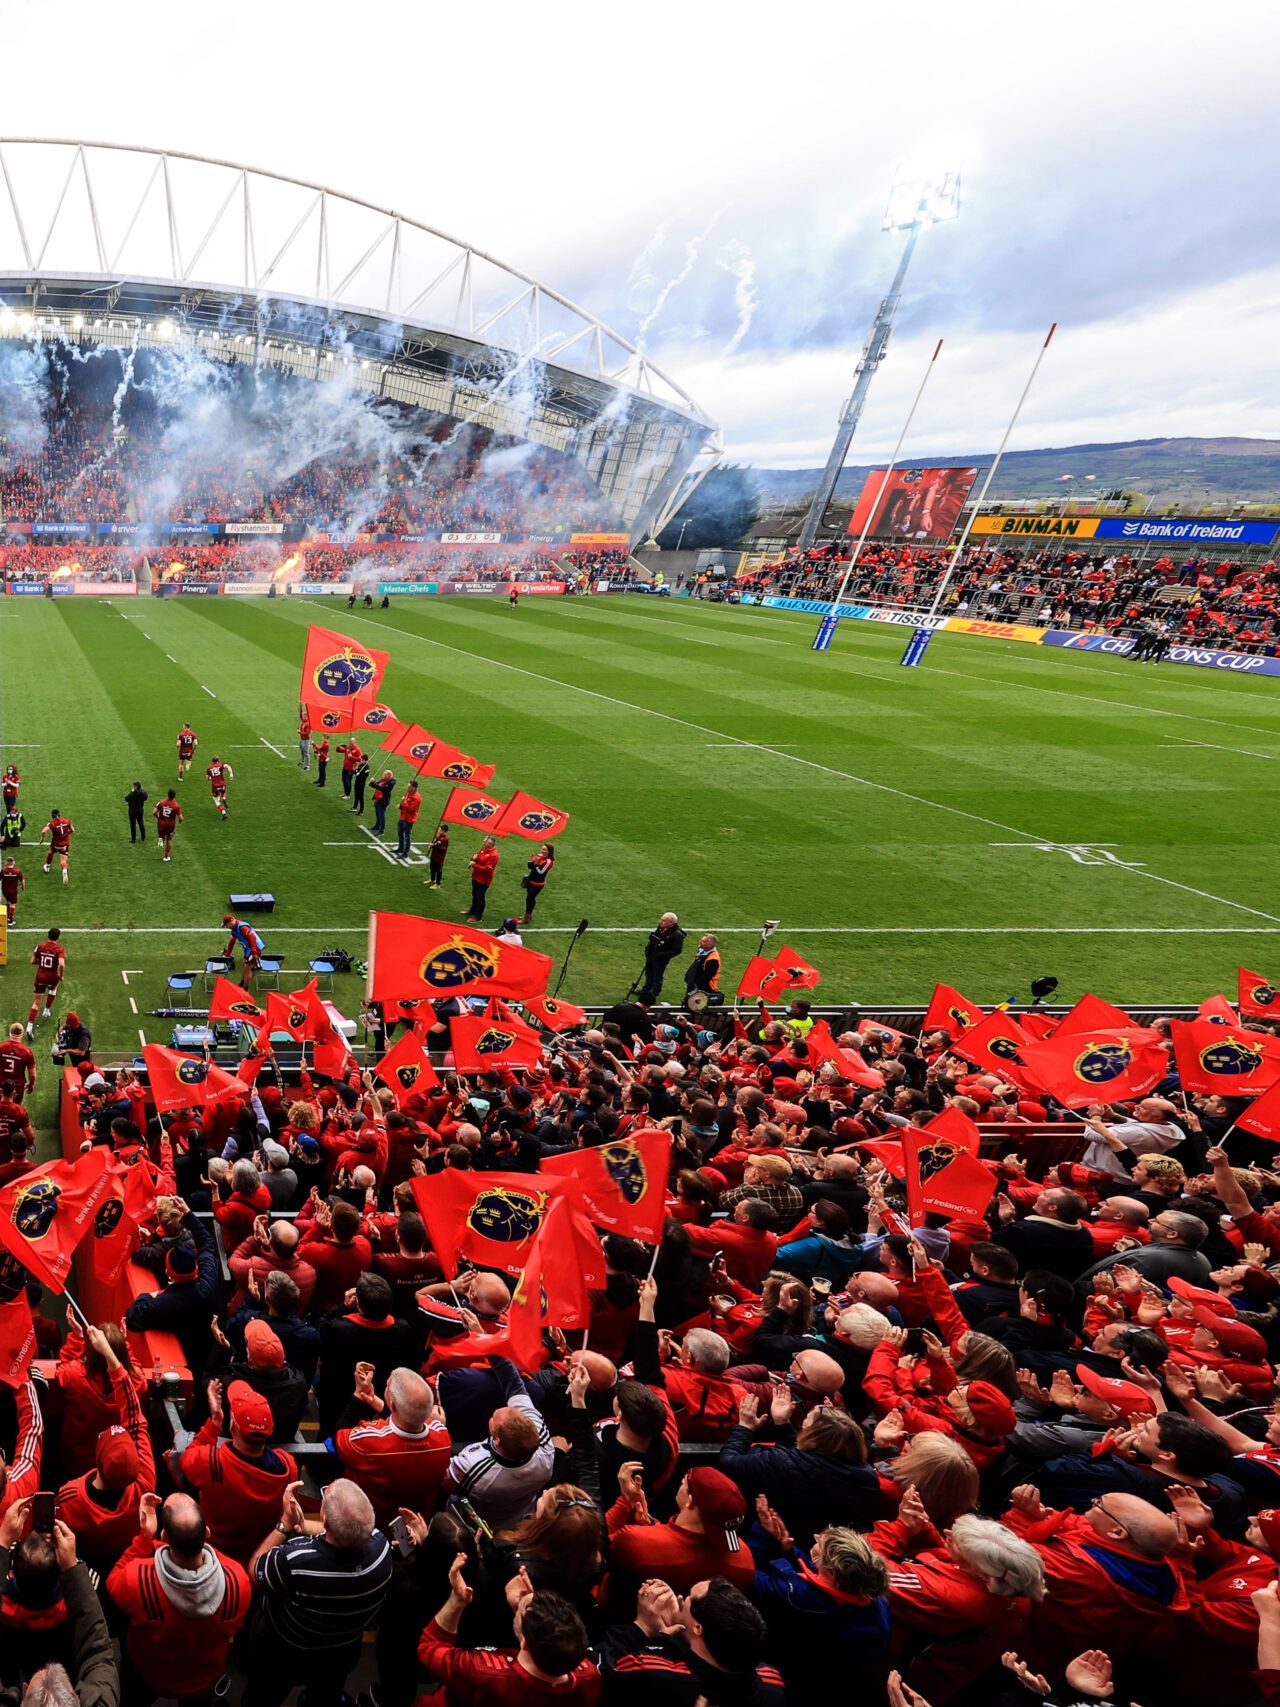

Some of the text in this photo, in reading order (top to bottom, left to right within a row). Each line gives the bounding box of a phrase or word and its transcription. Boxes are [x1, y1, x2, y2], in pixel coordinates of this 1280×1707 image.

[1001, 518, 1080, 535] BINMAN
[1139, 523, 1245, 539] Bank of Ireland
[400, 535, 425, 543] Pinergy
[182, 585, 208, 594] Pinergy
[408, 584, 429, 593] Chefs
[778, 599, 835, 614] MARSEILLE
[838, 604, 865, 617] 2022
[891, 613, 945, 628] TISSOT
[966, 622, 1018, 637] DHL
[1100, 639, 1266, 671] CHAIONS CUP
[210, 768, 221, 777] 15
[162, 807, 173, 817] 12
[40, 955, 54, 968] 10
[4, 1059, 15, 1073] 3
[934, 1198, 964, 1213] Ireland
